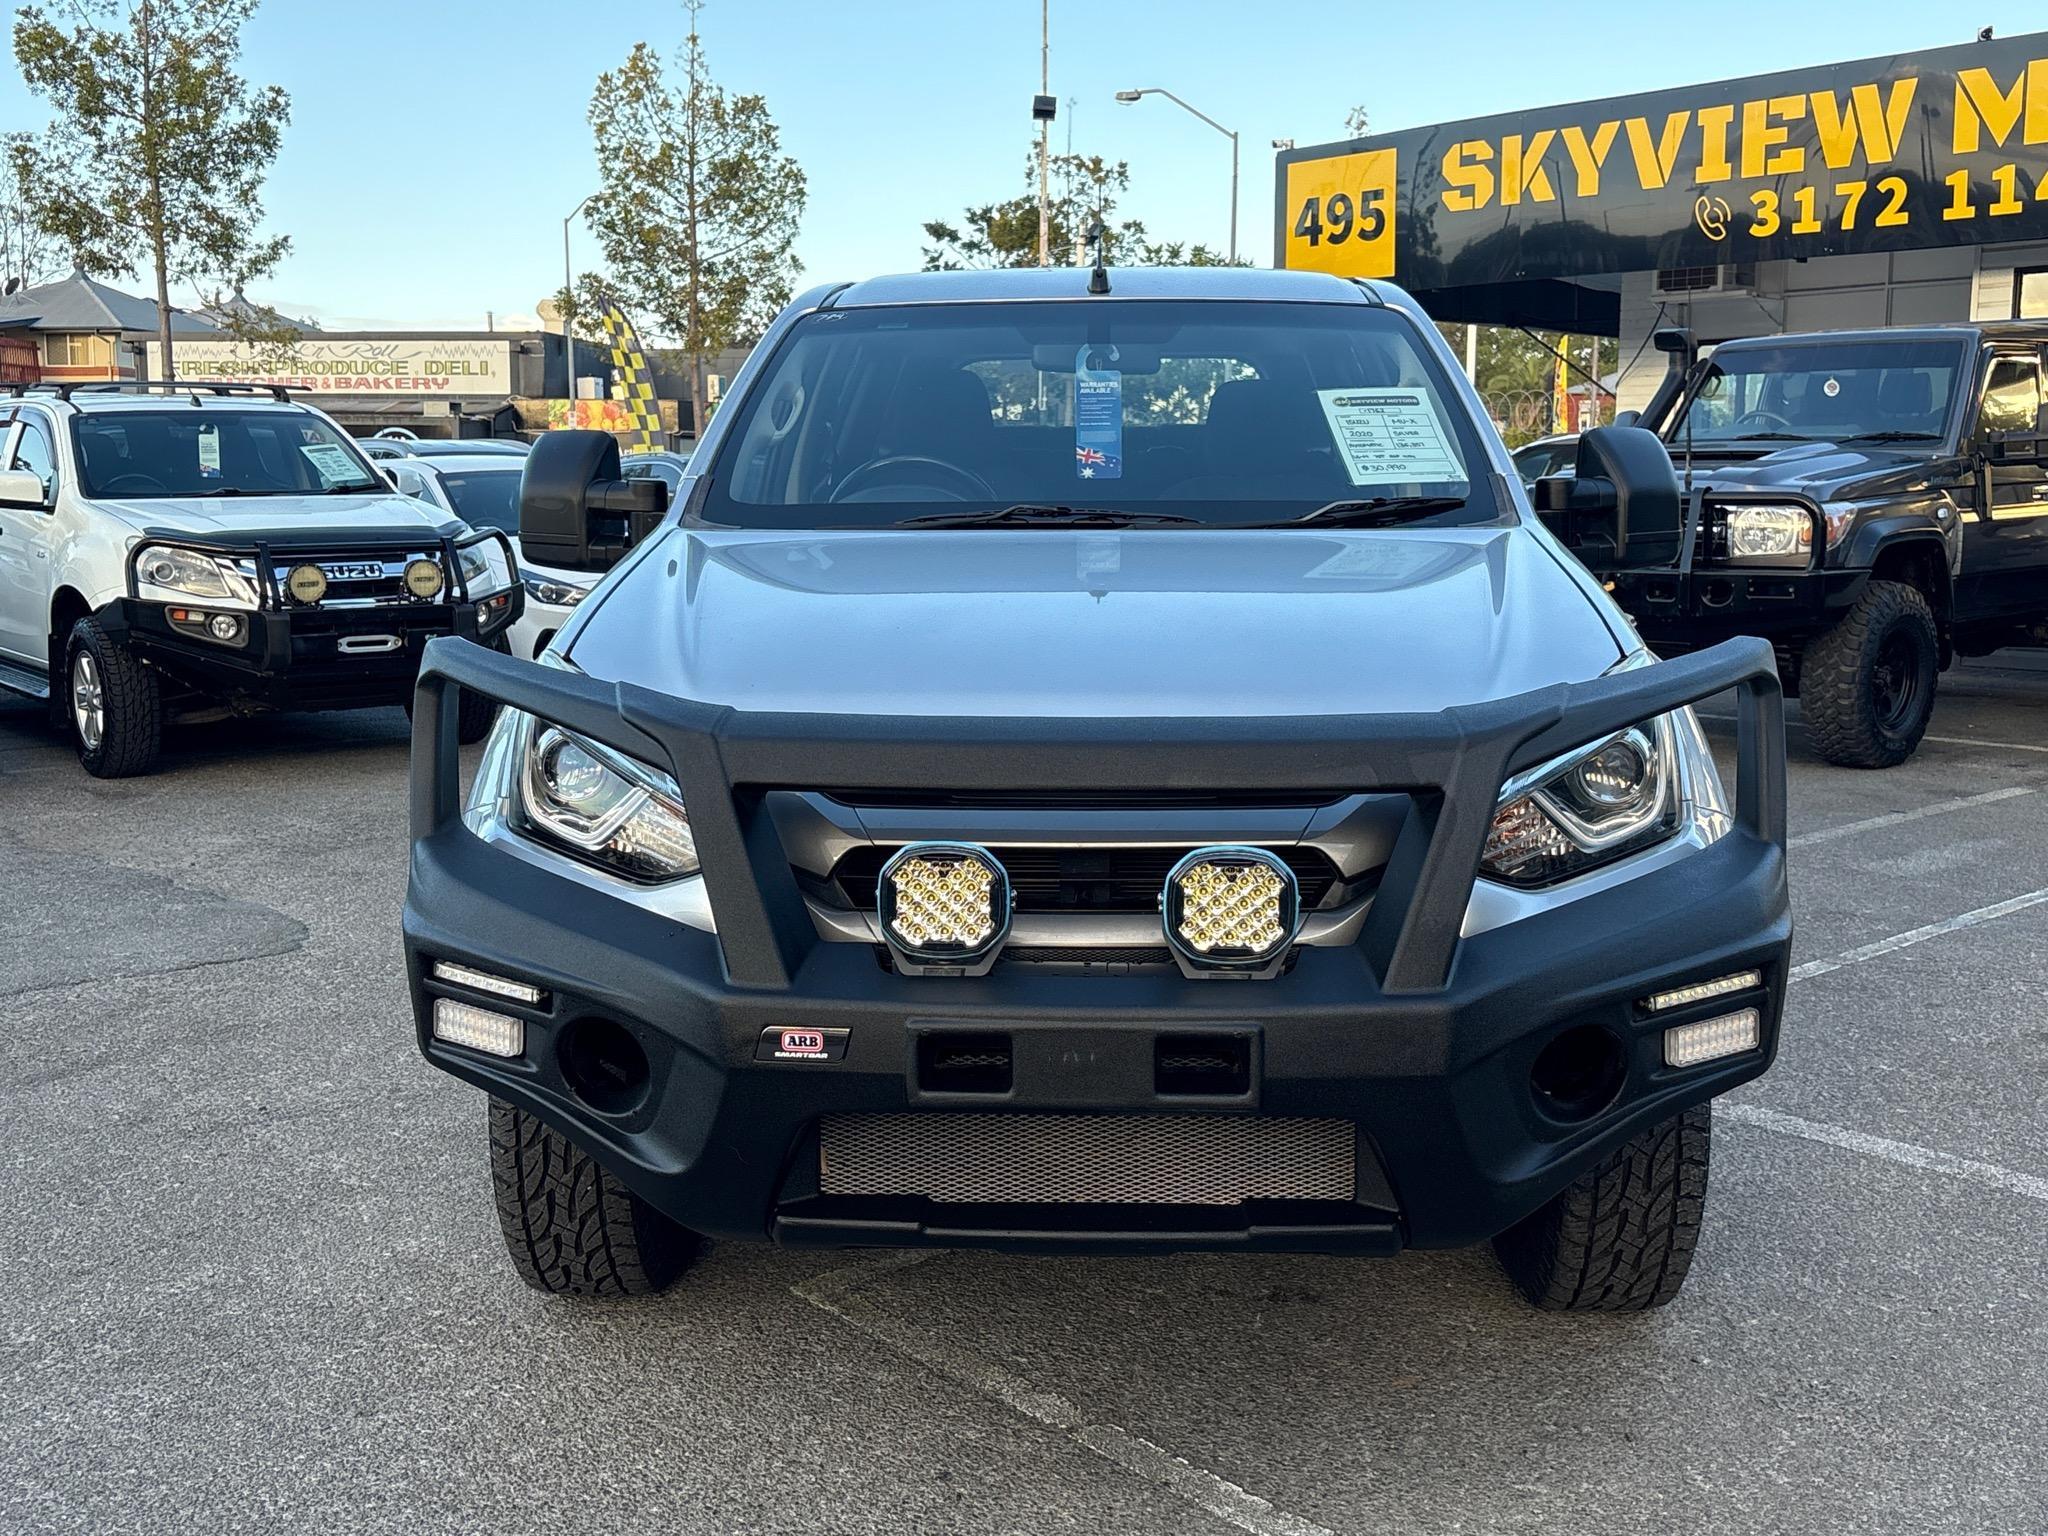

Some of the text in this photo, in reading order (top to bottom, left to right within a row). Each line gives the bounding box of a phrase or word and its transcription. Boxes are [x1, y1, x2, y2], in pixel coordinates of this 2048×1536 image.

[1441, 77, 1918, 212] SKYVIEW
[1294, 188, 1386, 247] 495
[1749, 176, 1909, 238] 3172
[321, 377, 331, 389] &
[334, 377, 449, 390] BAKERY
[322, 564, 380, 578] SUZU
[787, 1035, 818, 1046] ARB
